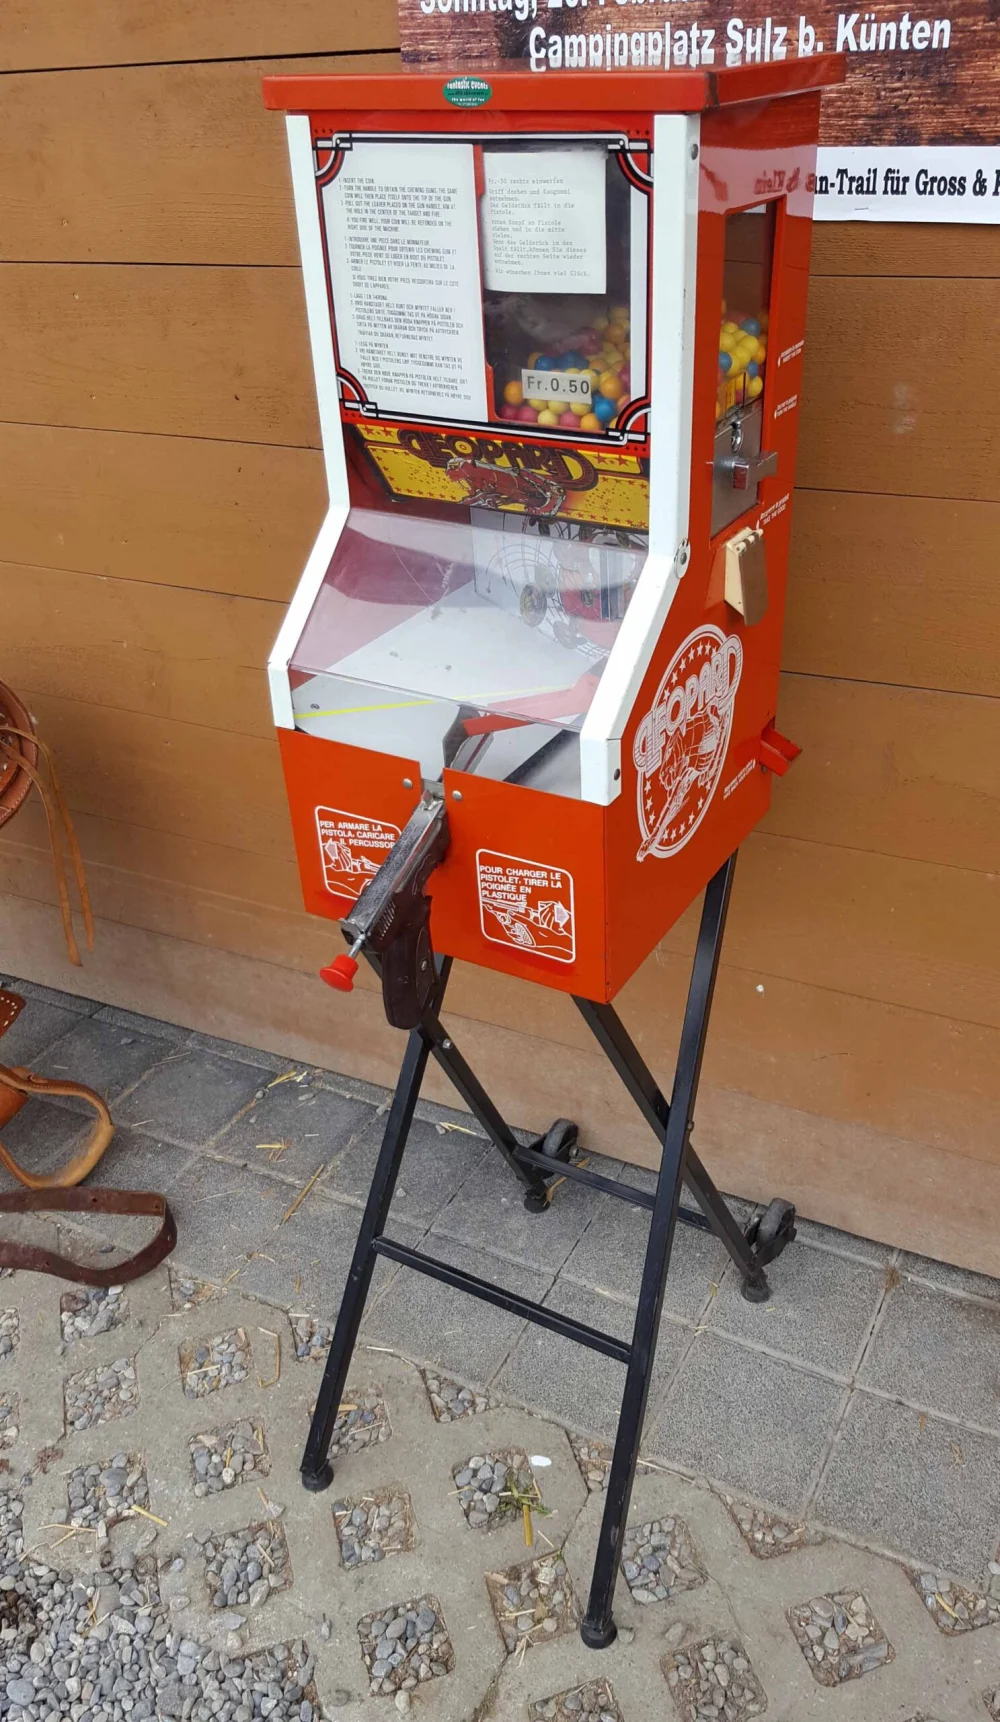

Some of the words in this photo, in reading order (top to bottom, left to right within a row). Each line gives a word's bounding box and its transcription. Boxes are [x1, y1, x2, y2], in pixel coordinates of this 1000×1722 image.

[726, 17, 788, 54] Sulz
[798, 16, 824, 52] b.
[836, 12, 951, 51] Künten
[882, 167, 910, 196] für
[915, 168, 967, 196] Gross
[972, 168, 987, 196] &
[320, 820, 335, 828] PER
[338, 821, 370, 831] ARMARE
[372, 824, 383, 832] LA
[356, 831, 396, 841] CARICARE
[480, 865, 503, 875] POUR
[506, 868, 548, 879] CHARGER
[550, 872, 561, 880] LE
[524, 878, 548, 888] TIRER
[551, 881, 562, 889] LA
[482, 889, 527, 900] PLASTIQUE
[520, 885, 532, 894] EN
